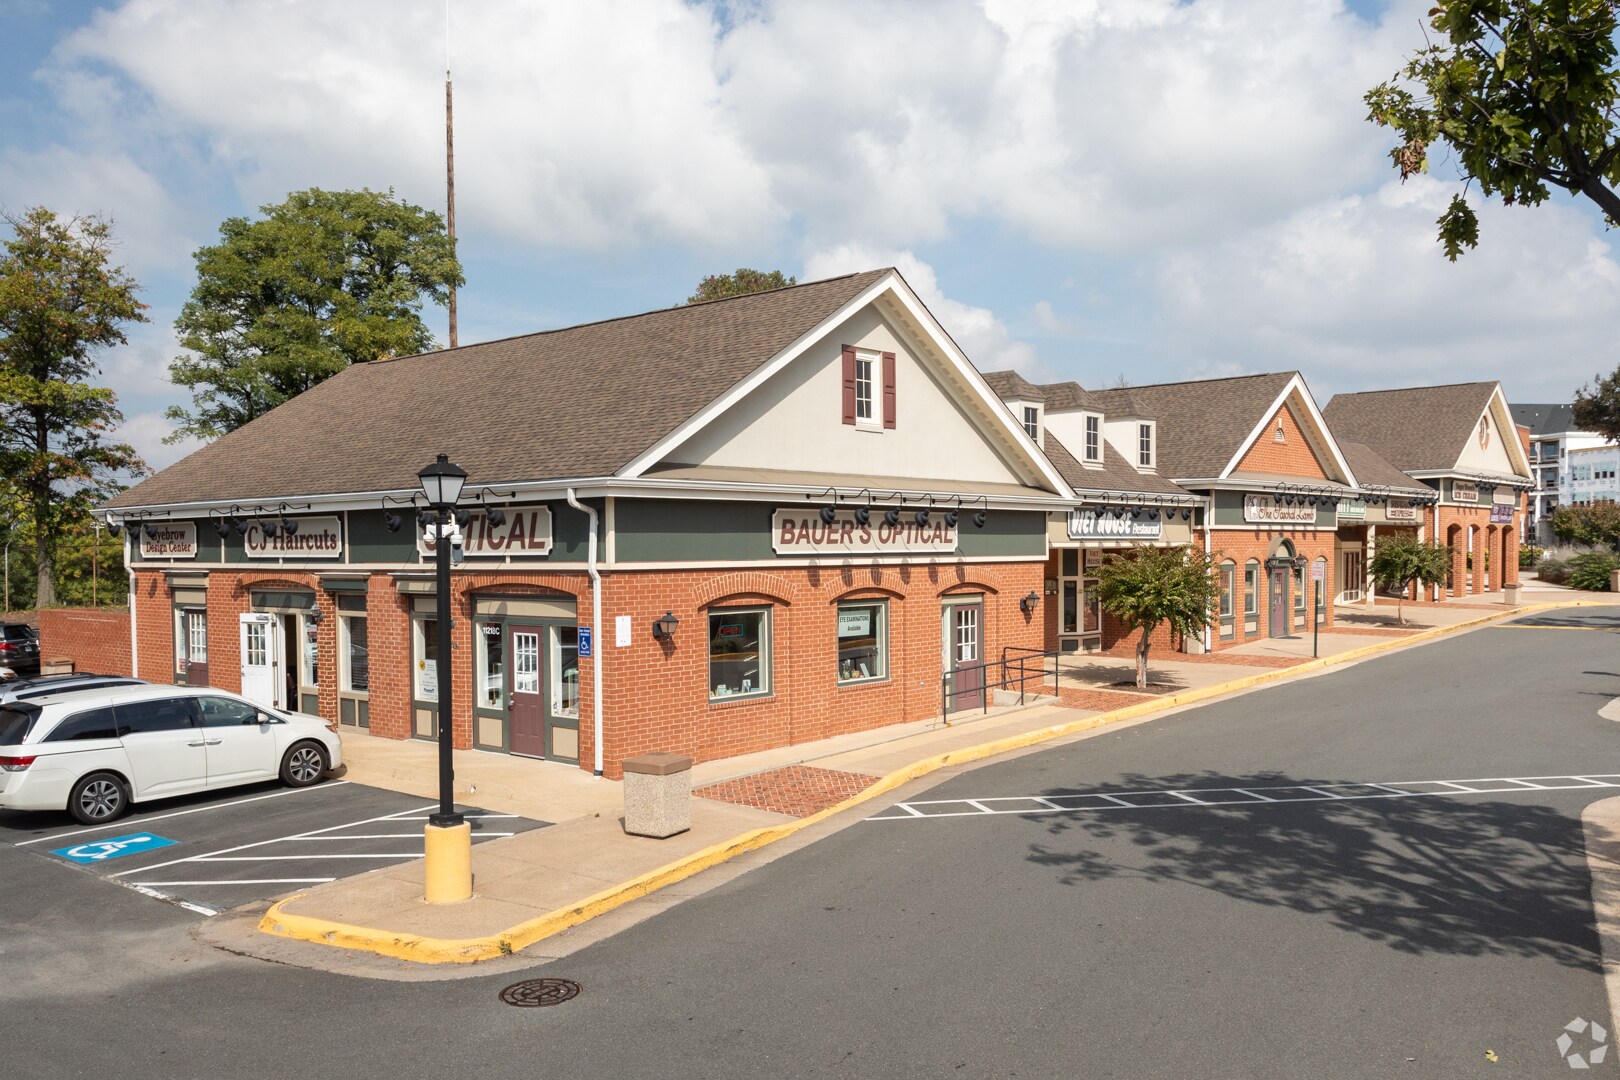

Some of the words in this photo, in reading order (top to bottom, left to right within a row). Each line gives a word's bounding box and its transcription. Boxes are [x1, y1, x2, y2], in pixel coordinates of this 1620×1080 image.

[247, 525, 267, 551] CJ
[272, 525, 338, 551] Haircuts
[424, 511, 546, 552] TICAL
[780, 518, 873, 545] BAUER'S
[877, 519, 953, 545] OPTICAL
[146, 541, 168, 555] Design
[168, 540, 192, 553] Center
